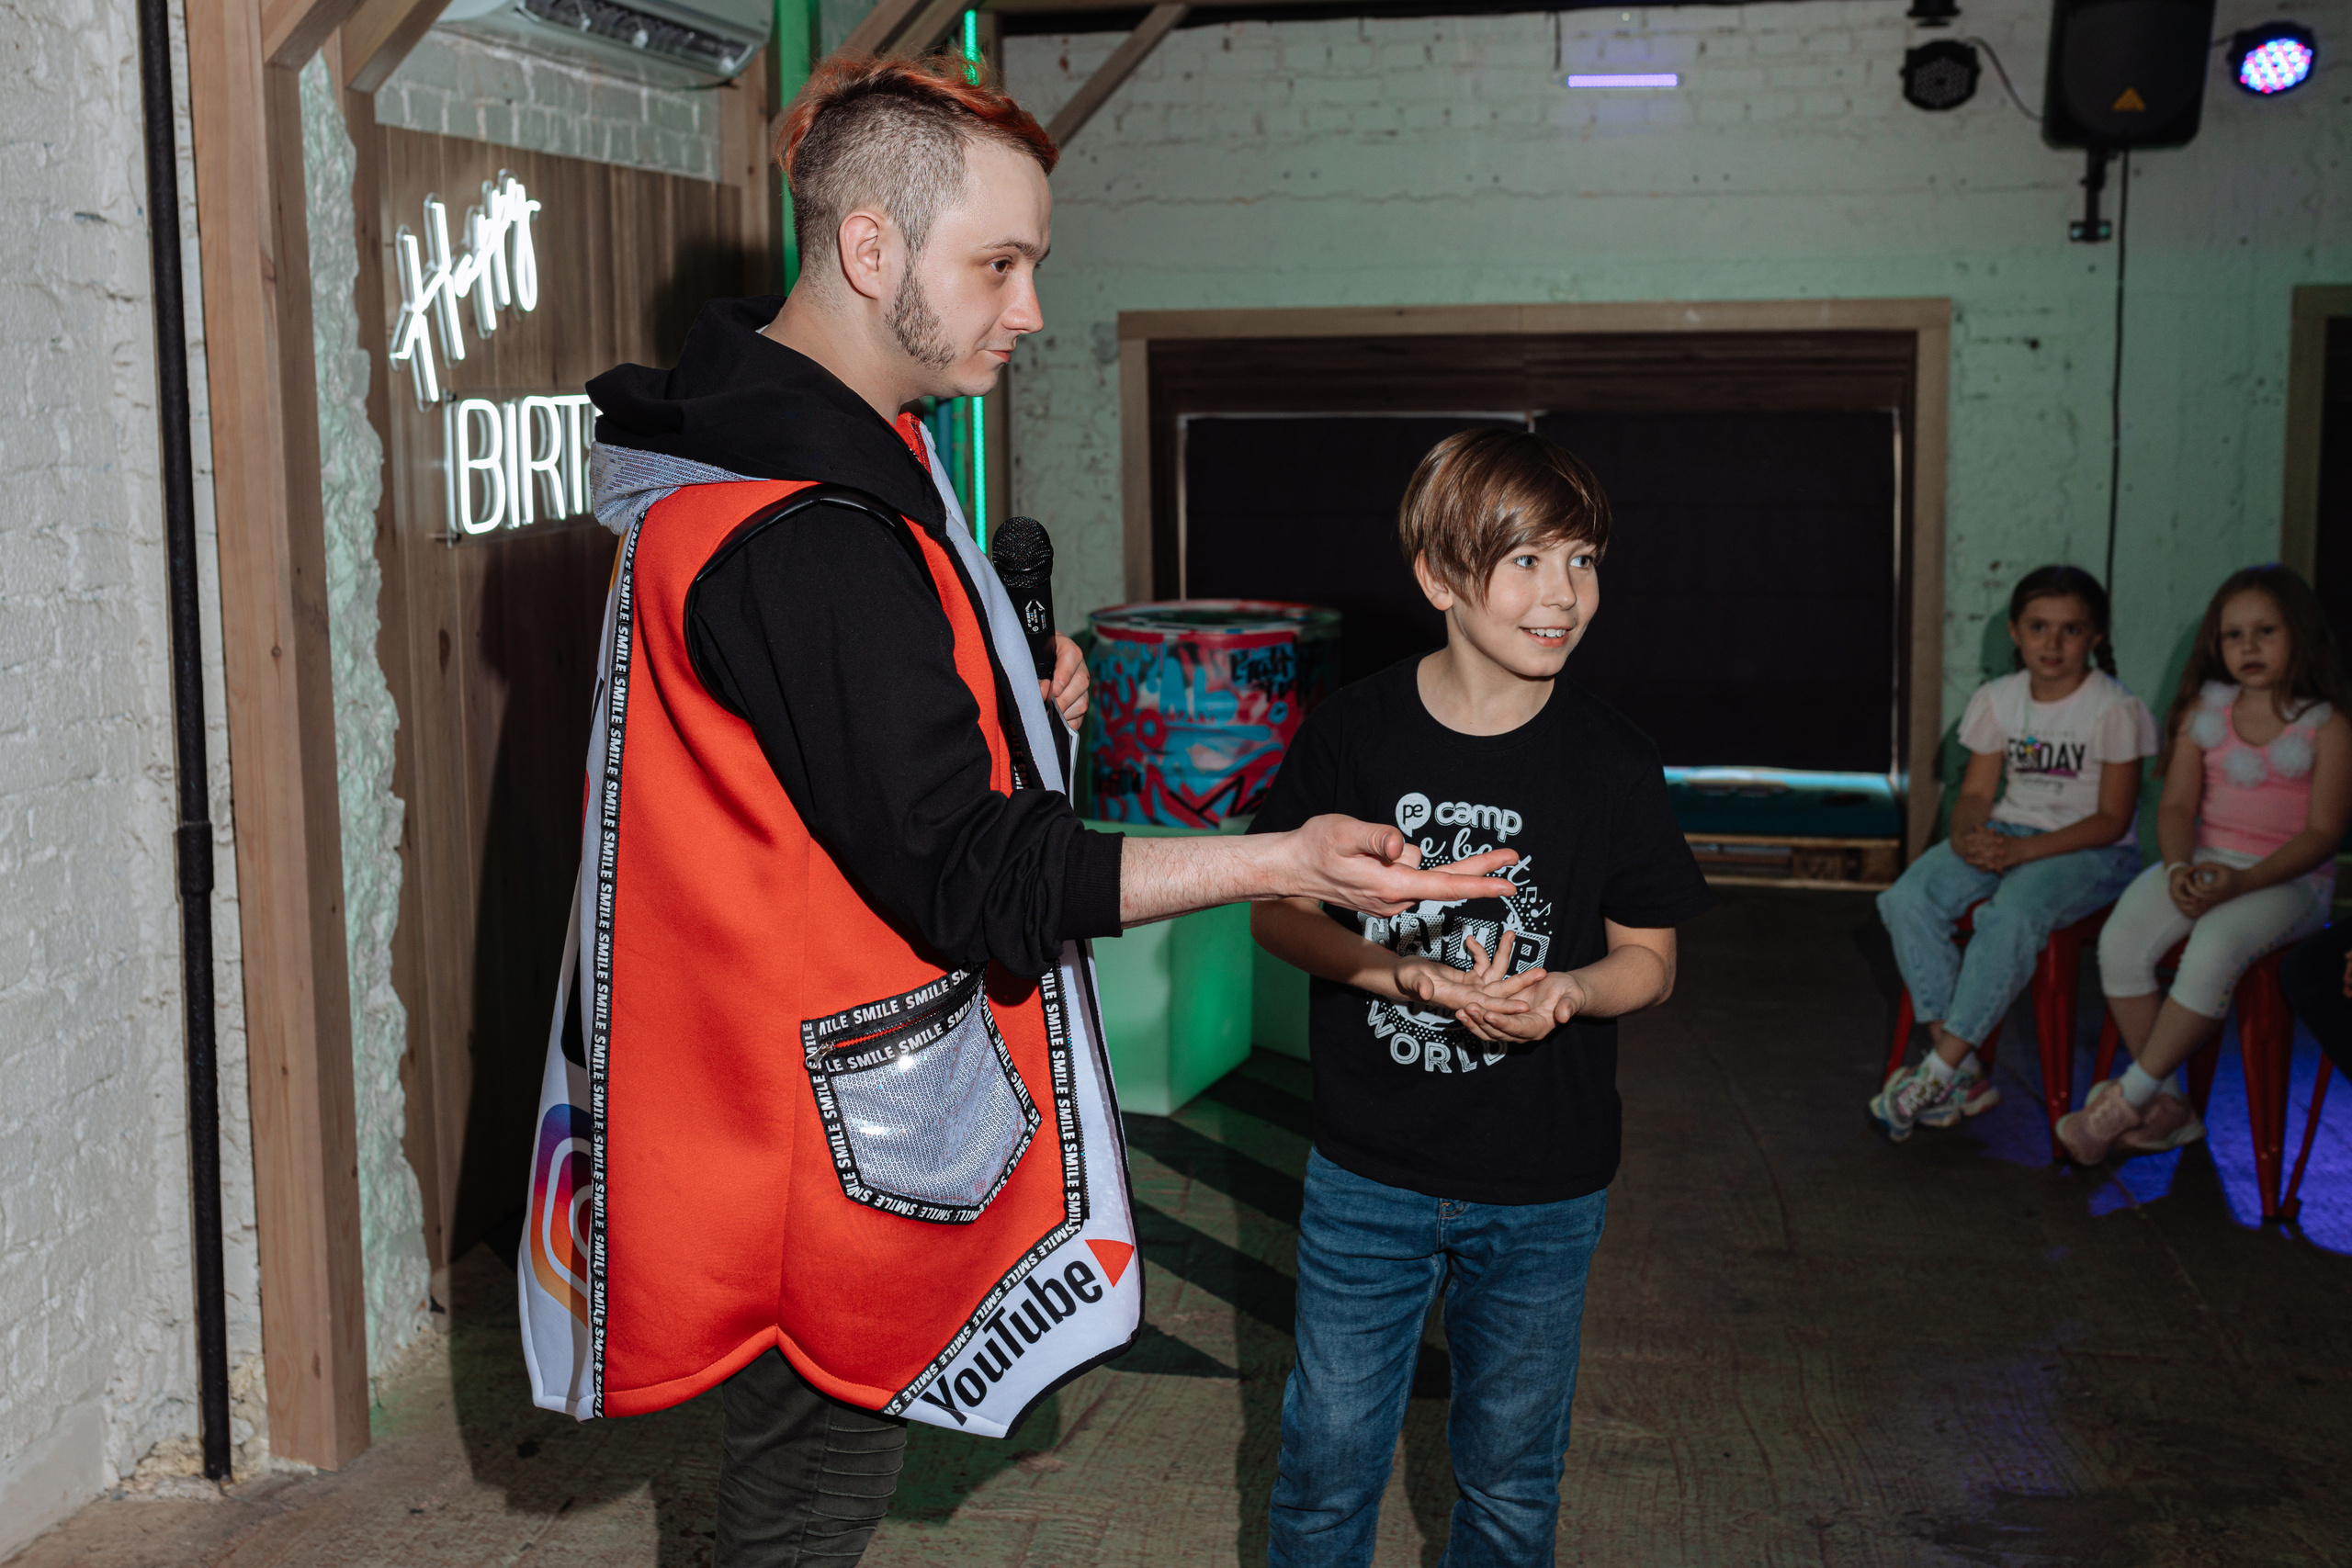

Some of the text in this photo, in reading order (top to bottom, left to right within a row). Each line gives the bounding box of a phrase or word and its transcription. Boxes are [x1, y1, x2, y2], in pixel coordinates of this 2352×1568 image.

[393, 177, 541, 402] Happy
[458, 395, 602, 535] BIRT
[618, 573, 631, 622] SMILE
[614, 625, 628, 673] SMILE
[610, 676, 627, 725] SMILE
[606, 728, 622, 775] SMILE
[603, 780, 618, 829] SMILE
[1402, 801, 1522, 843] pe camp
[600, 830, 616, 879] SMILE
[598, 882, 613, 930] SMILE
[596, 931, 610, 979] SMILE
[594, 982, 609, 1030] SMILE
[854, 999, 900, 1024] SMILE
[905, 979, 950, 1010] SMILE
[1046, 1003, 1064, 1046] SMILE
[593, 1033, 606, 1081] SMILE
[847, 1045, 895, 1069] SMILE
[898, 1022, 944, 1055] SMILE
[993, 1032, 1013, 1073] SMILE
[1367, 999, 1508, 1073] WORLD
[1052, 1050, 1069, 1095] SMILE
[593, 1083, 605, 1131] SMILE
[813, 1073, 838, 1120] SMILE
[1057, 1099, 1076, 1141] SMILE
[593, 1133, 605, 1180] SMILE
[827, 1122, 852, 1169] SMILE
[1005, 1135, 1031, 1177] SMILE
[1064, 1143, 1080, 1188] SMILE
[593, 1182, 605, 1229] SMILE
[874, 1194, 919, 1217] SMILE
[918, 1205, 953, 1223] SMILE
[593, 1280, 605, 1326] SMILE
[901, 1223, 1076, 1403] SMILE SMILE SMILE SMILE SMILE
[593, 1327, 605, 1372] SMILE
[919, 1260, 1102, 1427] YouTube
